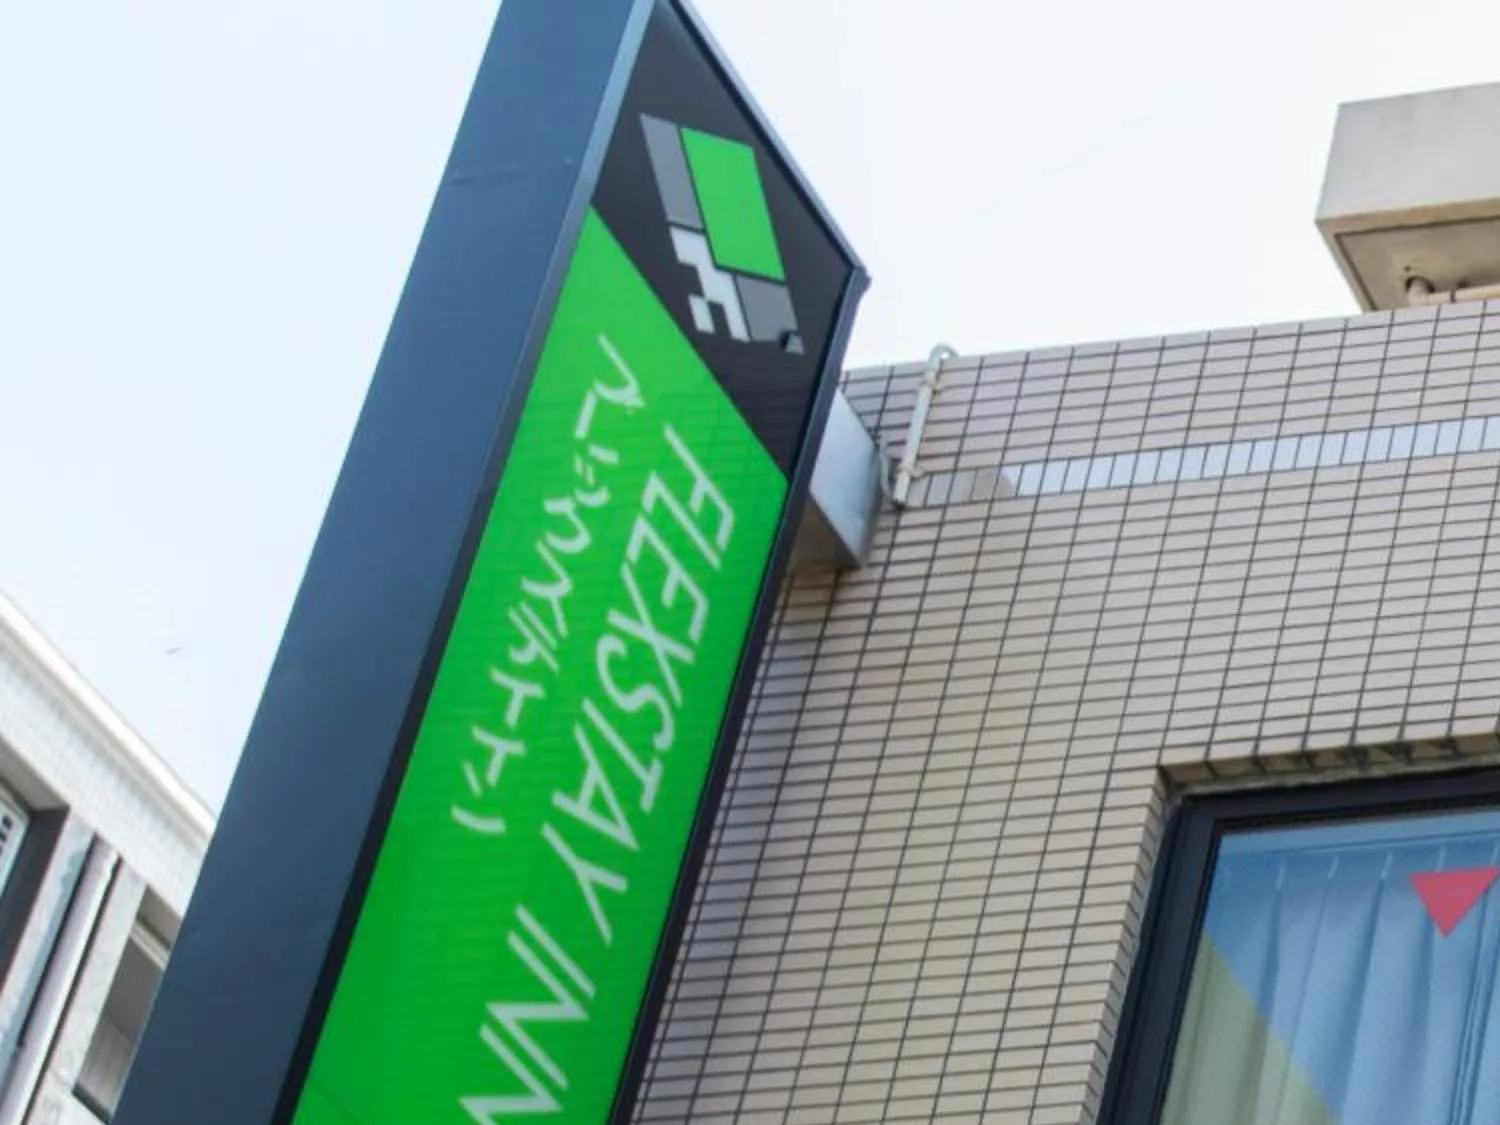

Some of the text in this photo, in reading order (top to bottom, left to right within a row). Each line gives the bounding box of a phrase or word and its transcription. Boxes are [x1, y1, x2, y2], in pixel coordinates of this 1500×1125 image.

[451, 333, 646, 834] フレックステイイン
[543, 424, 735, 943] FLEXSTAY
